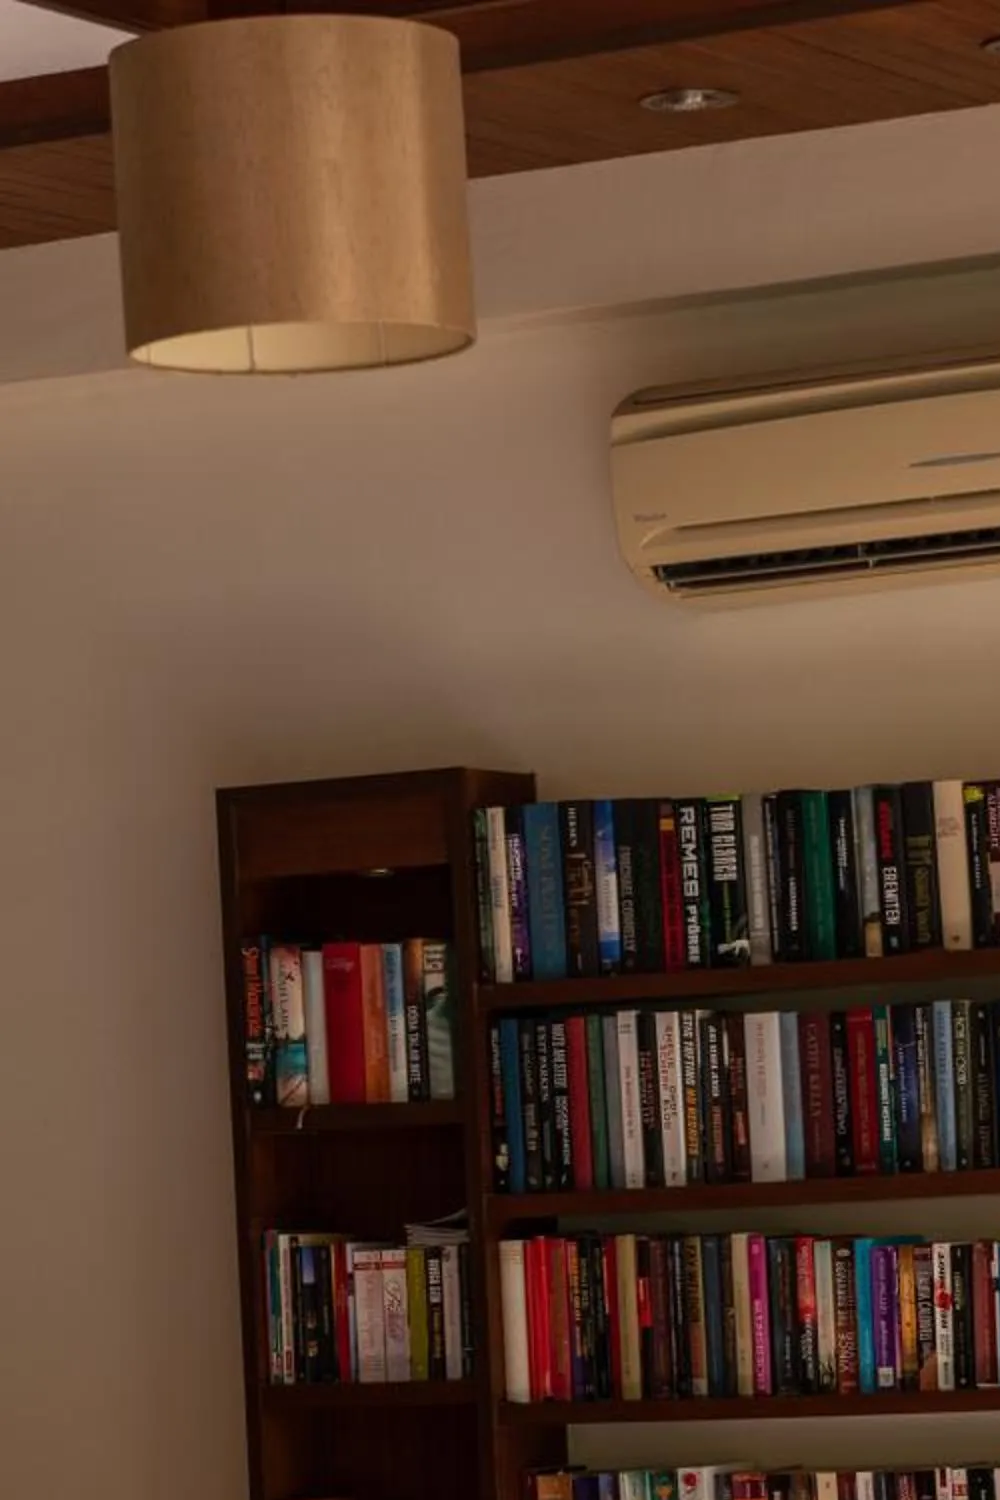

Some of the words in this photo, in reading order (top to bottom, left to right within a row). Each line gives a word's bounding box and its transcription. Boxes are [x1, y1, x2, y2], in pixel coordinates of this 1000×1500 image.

[710, 803, 736, 833] TOM
[679, 806, 699, 898] REMES
[712, 834, 738, 882] CLANCY
